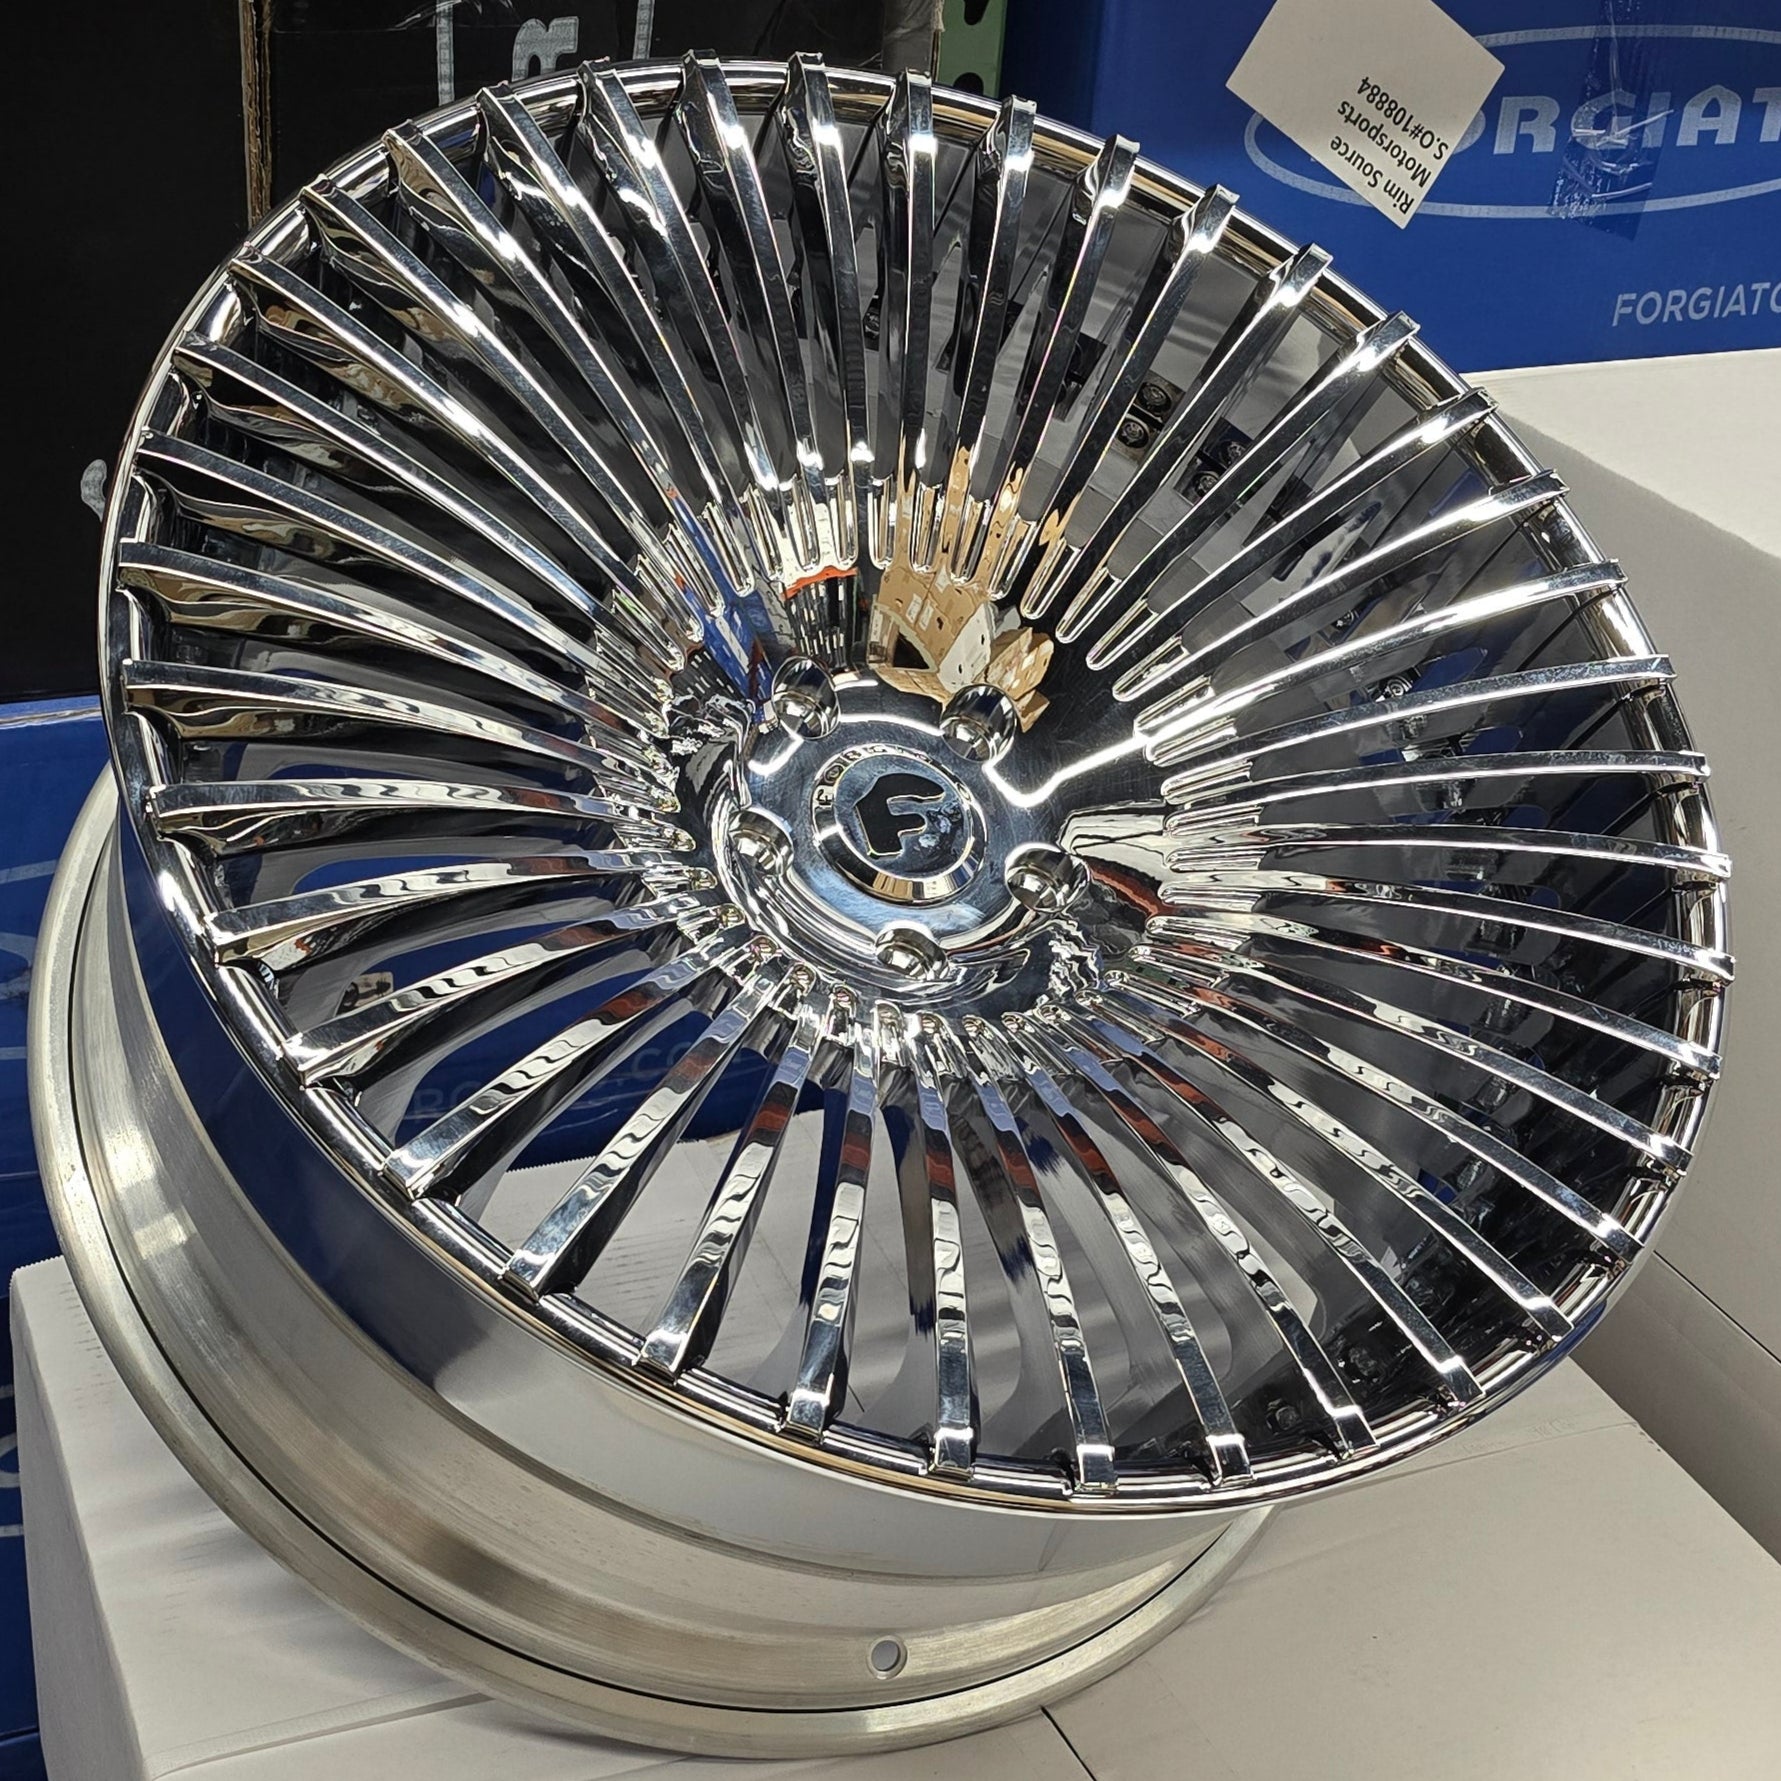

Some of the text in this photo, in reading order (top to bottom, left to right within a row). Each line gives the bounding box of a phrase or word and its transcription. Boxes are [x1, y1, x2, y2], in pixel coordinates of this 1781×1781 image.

[1337, 100, 1432, 188] Motorsports
[1356, 76, 1449, 160] S.O#108884
[1329, 135, 1415, 215] Rim Source
